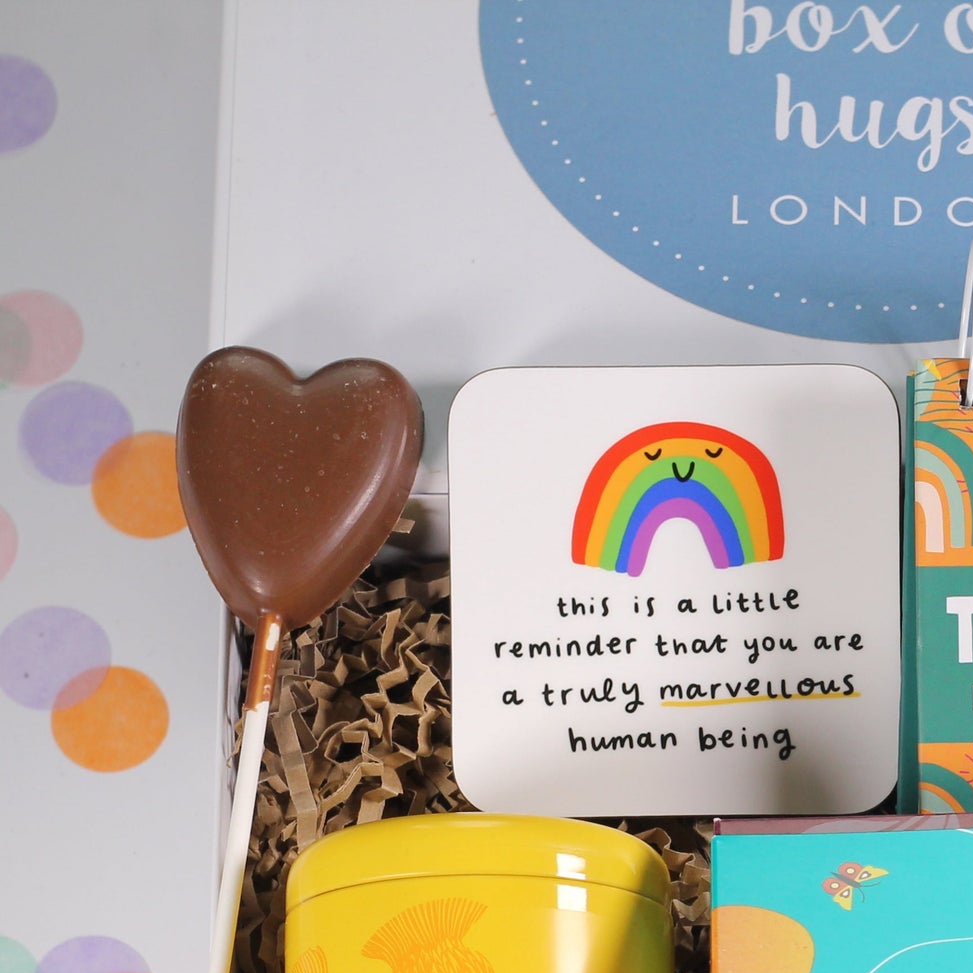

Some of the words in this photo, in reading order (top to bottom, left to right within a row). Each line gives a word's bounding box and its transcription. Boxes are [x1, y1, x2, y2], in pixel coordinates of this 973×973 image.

[728, 0, 919, 55] box
[557, 596, 610, 617] this
[634, 596, 655, 617] is
[678, 598, 697, 613] a
[713, 588, 799, 614] little
[495, 635, 637, 658] reminder
[655, 633, 728, 656] that
[744, 636, 797, 663] you
[814, 632, 864, 651] are
[502, 688, 523, 706] a
[542, 679, 644, 713] truly
[660, 673, 856, 700] marvellous
[568, 727, 677, 752] human
[699, 726, 796, 760] being
